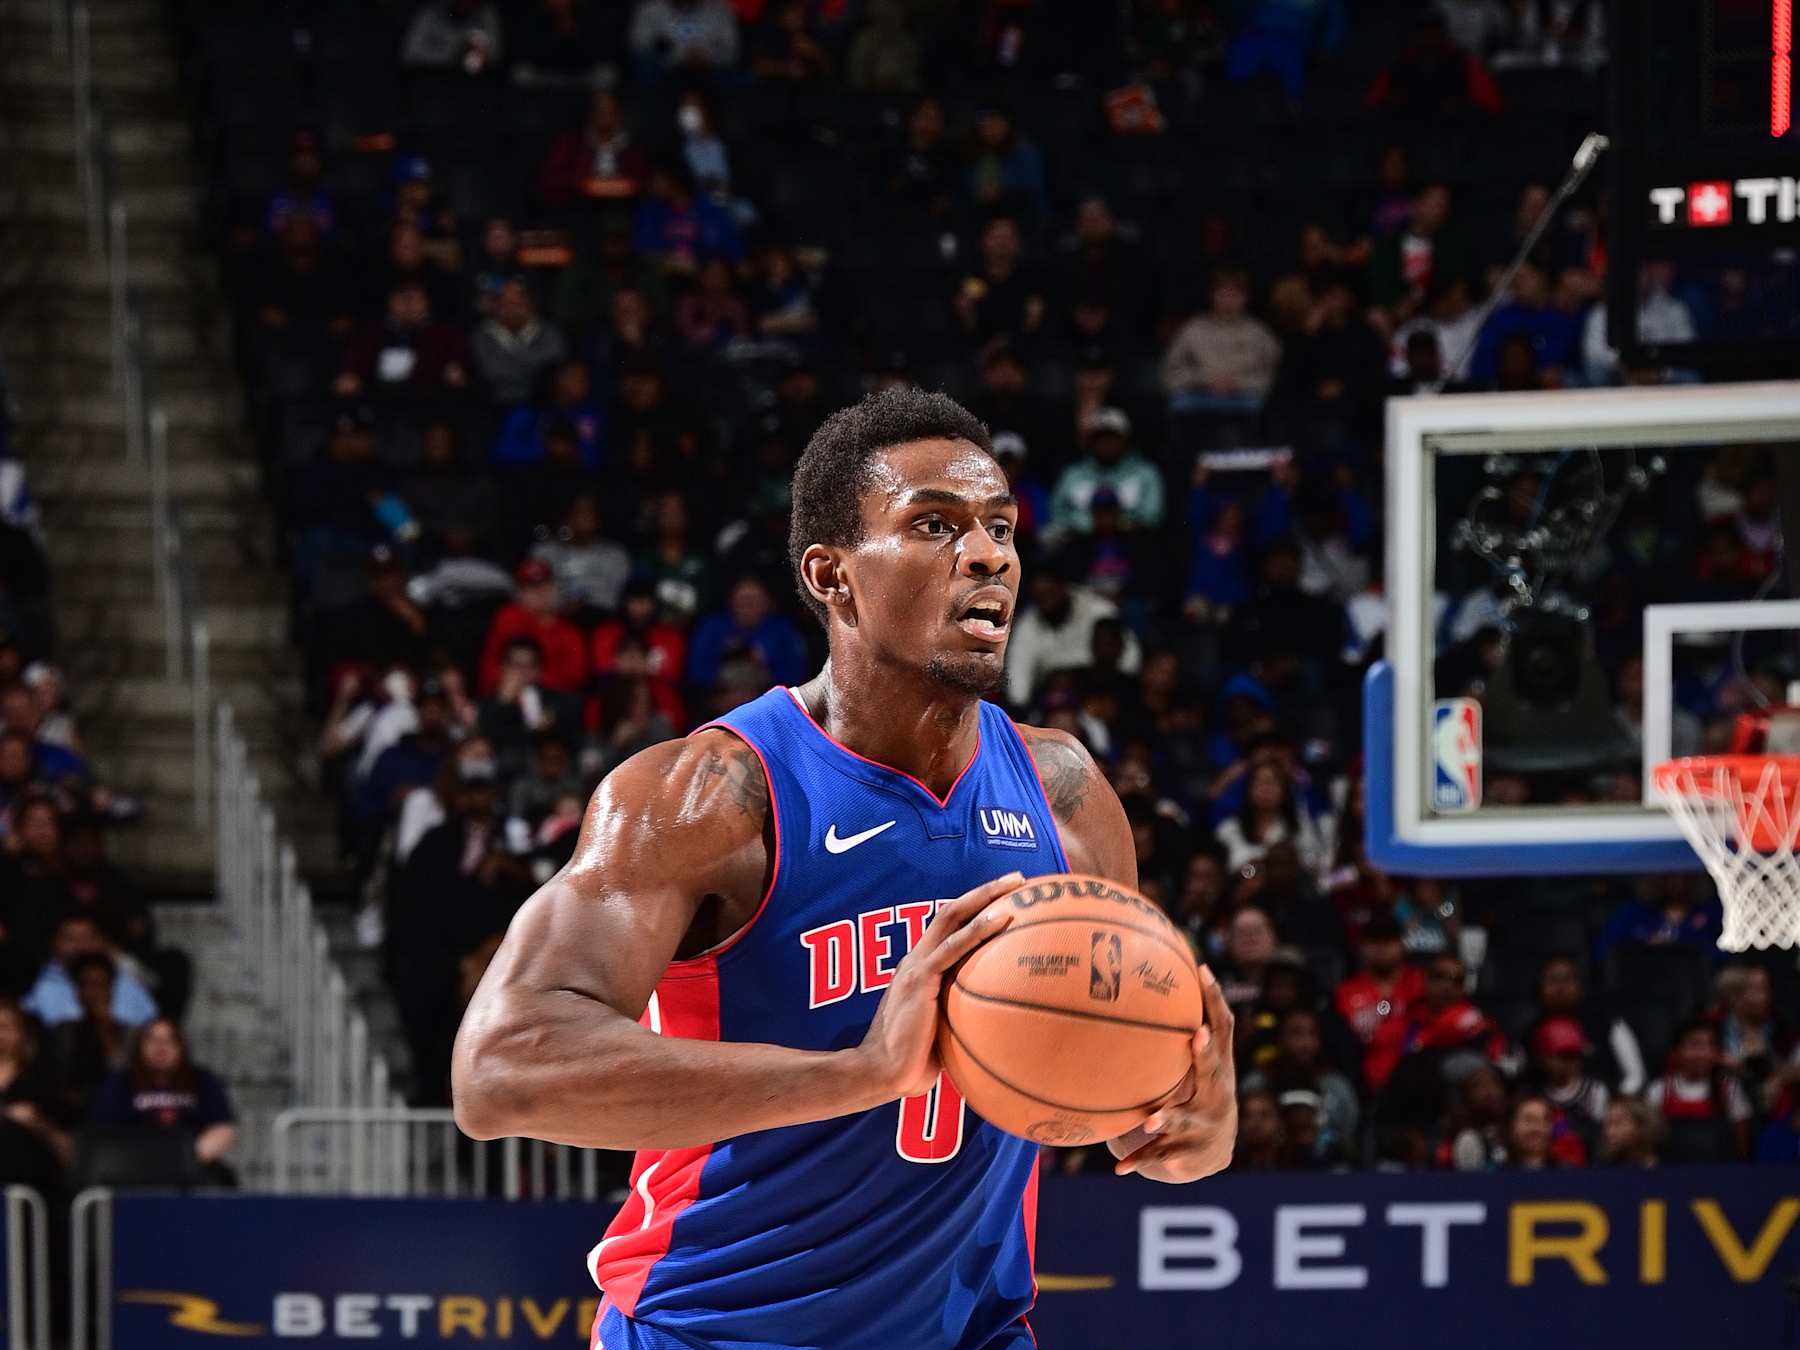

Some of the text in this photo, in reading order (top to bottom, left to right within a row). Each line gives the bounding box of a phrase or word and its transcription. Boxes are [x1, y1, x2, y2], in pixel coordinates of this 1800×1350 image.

[1734, 176, 1800, 224] TI
[980, 809, 1035, 839] UWM
[800, 899, 958, 1009] DET
[1138, 1199, 1800, 1290] BETRIV
